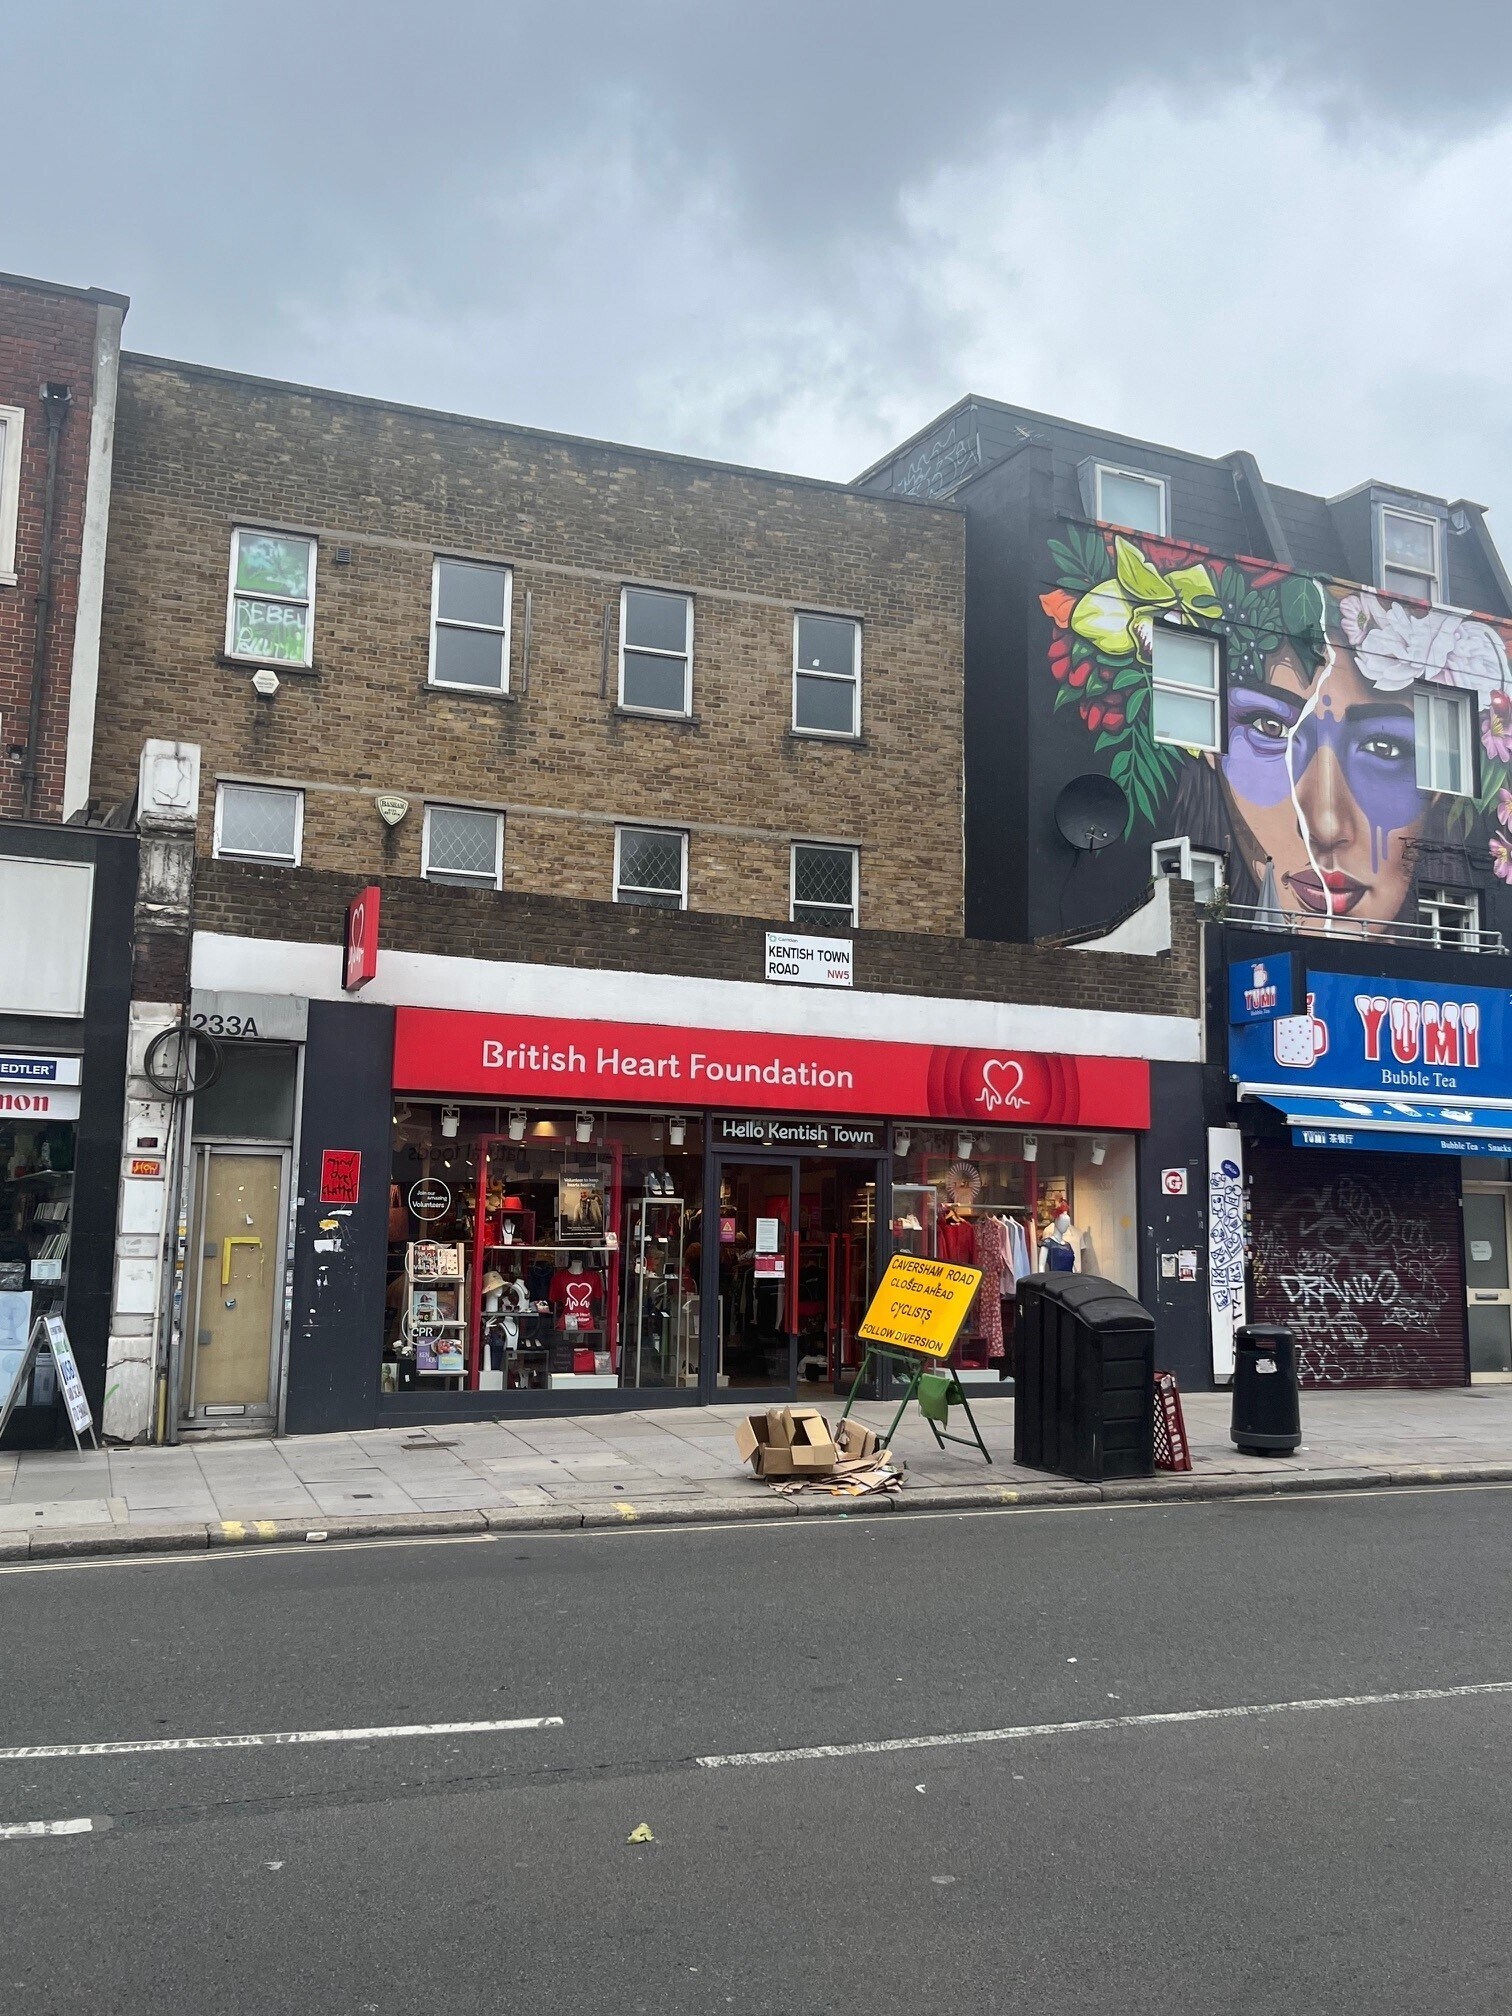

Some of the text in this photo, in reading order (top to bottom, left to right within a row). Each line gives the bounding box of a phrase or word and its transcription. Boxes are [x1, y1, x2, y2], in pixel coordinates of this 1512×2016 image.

[237, 599, 305, 631] REBEL
[769, 945, 850, 964] KENTISH TOWN
[769, 962, 850, 980] ROAD NW5
[1244, 985, 1276, 1011] YUMI
[192, 1013, 259, 1037] 233A
[1354, 994, 1479, 1068] YUMI
[482, 1040, 854, 1089] British Heart Foundation
[1381, 1069, 1456, 1088] Bubble Tea
[722, 1120, 874, 1143] Hello Kentish Town
[1302, 1130, 1326, 1144] YUMI
[1440, 1140, 1465, 1150] Bubble
[1465, 1141, 1478, 1151] Tea
[1487, 1143, 1512, 1153] Snacks
[412, 1200, 445, 1208] Volunteers
[891, 1258, 975, 1286] CAVERSHAM ROAD
[890, 1277, 954, 1300] CLOSED AHEAD
[890, 1301, 933, 1321] CYCLISTS
[411, 1327, 433, 1337] CPR
[861, 1323, 944, 1352] FOLLOW DIVERSION
